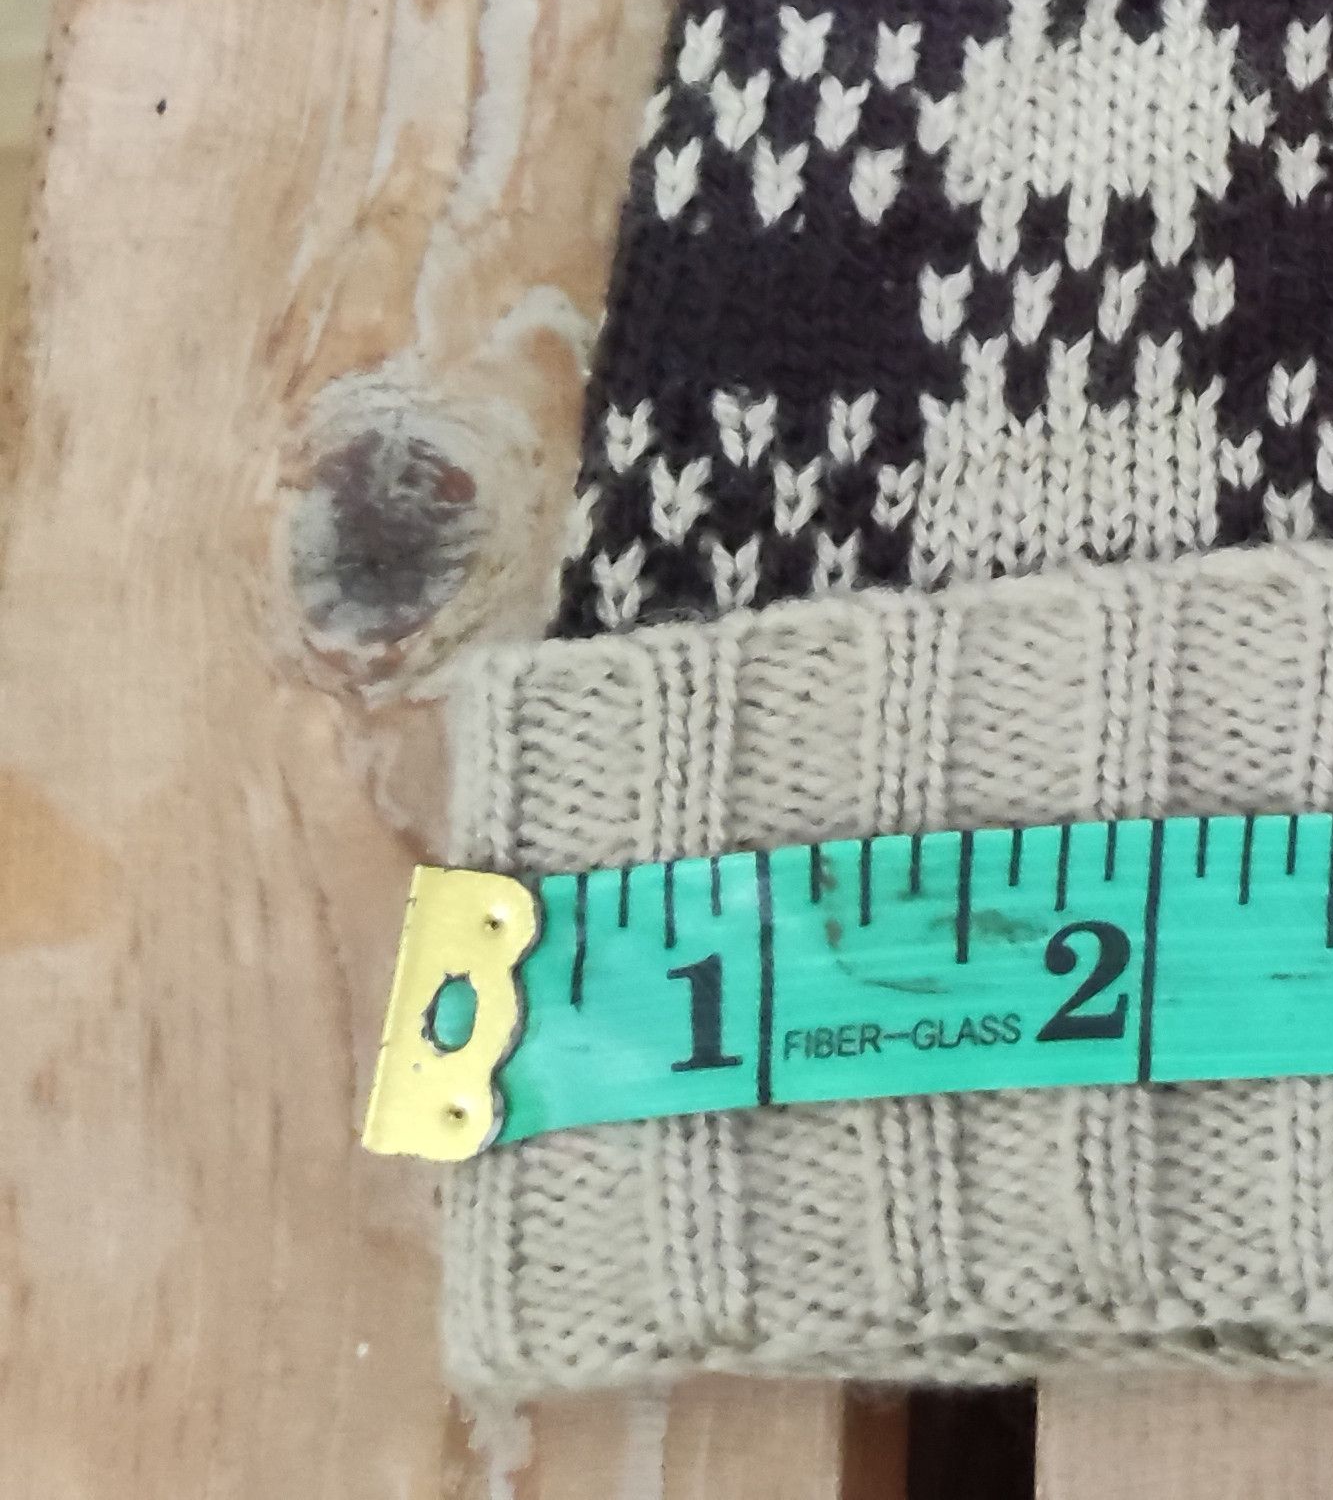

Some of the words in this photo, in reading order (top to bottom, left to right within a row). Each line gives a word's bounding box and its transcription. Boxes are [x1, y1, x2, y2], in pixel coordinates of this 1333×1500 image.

[666, 953, 742, 1073] 1
[783, 1013, 1022, 1060] FIBER-GLASS
[1036, 920, 1132, 1042] 2
